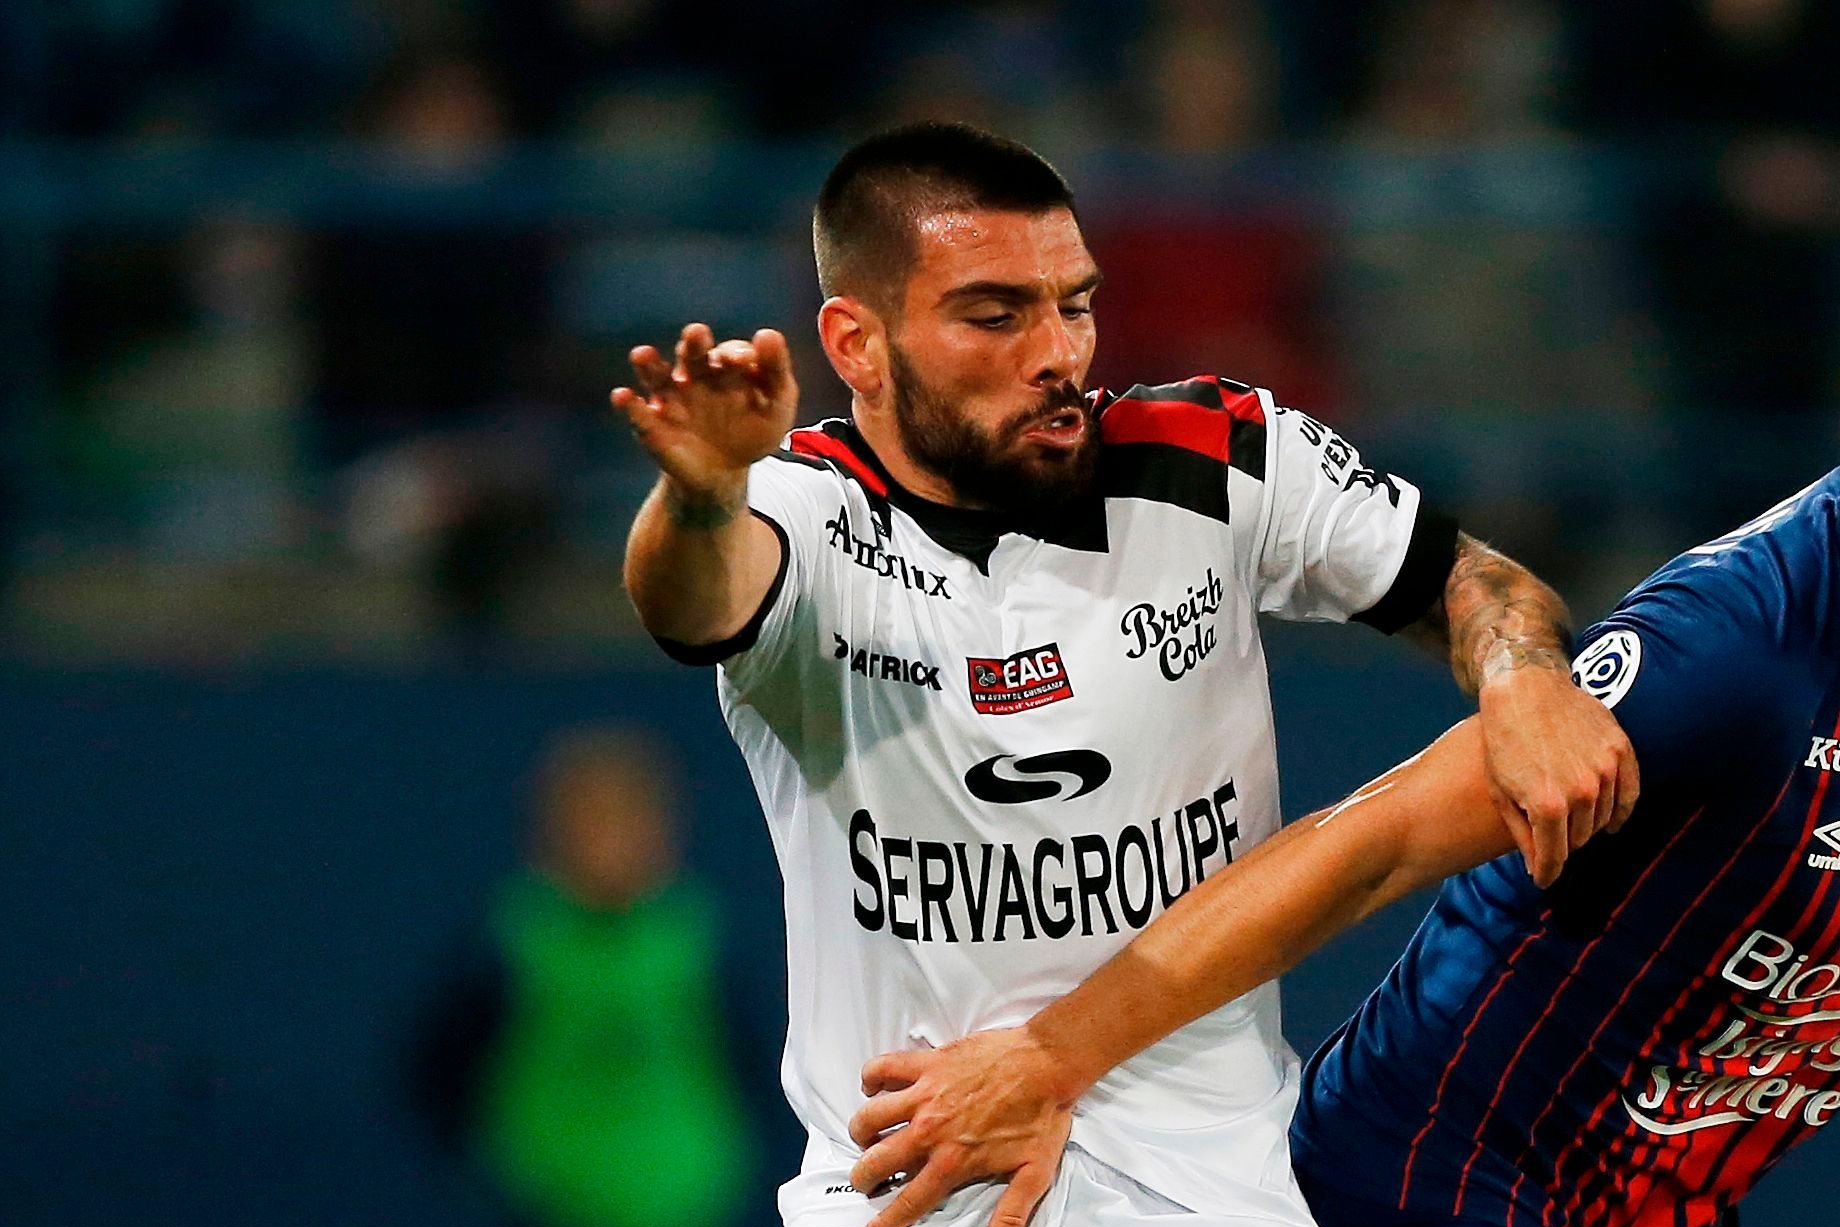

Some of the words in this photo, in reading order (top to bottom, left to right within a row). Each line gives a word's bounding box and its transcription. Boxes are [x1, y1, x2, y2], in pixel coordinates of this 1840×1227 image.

[1121, 567, 1224, 659] Breizh
[1003, 651, 1059, 689] EAG
[1159, 623, 1217, 682] Cola
[848, 776, 1241, 945] SERVAGROUPE
